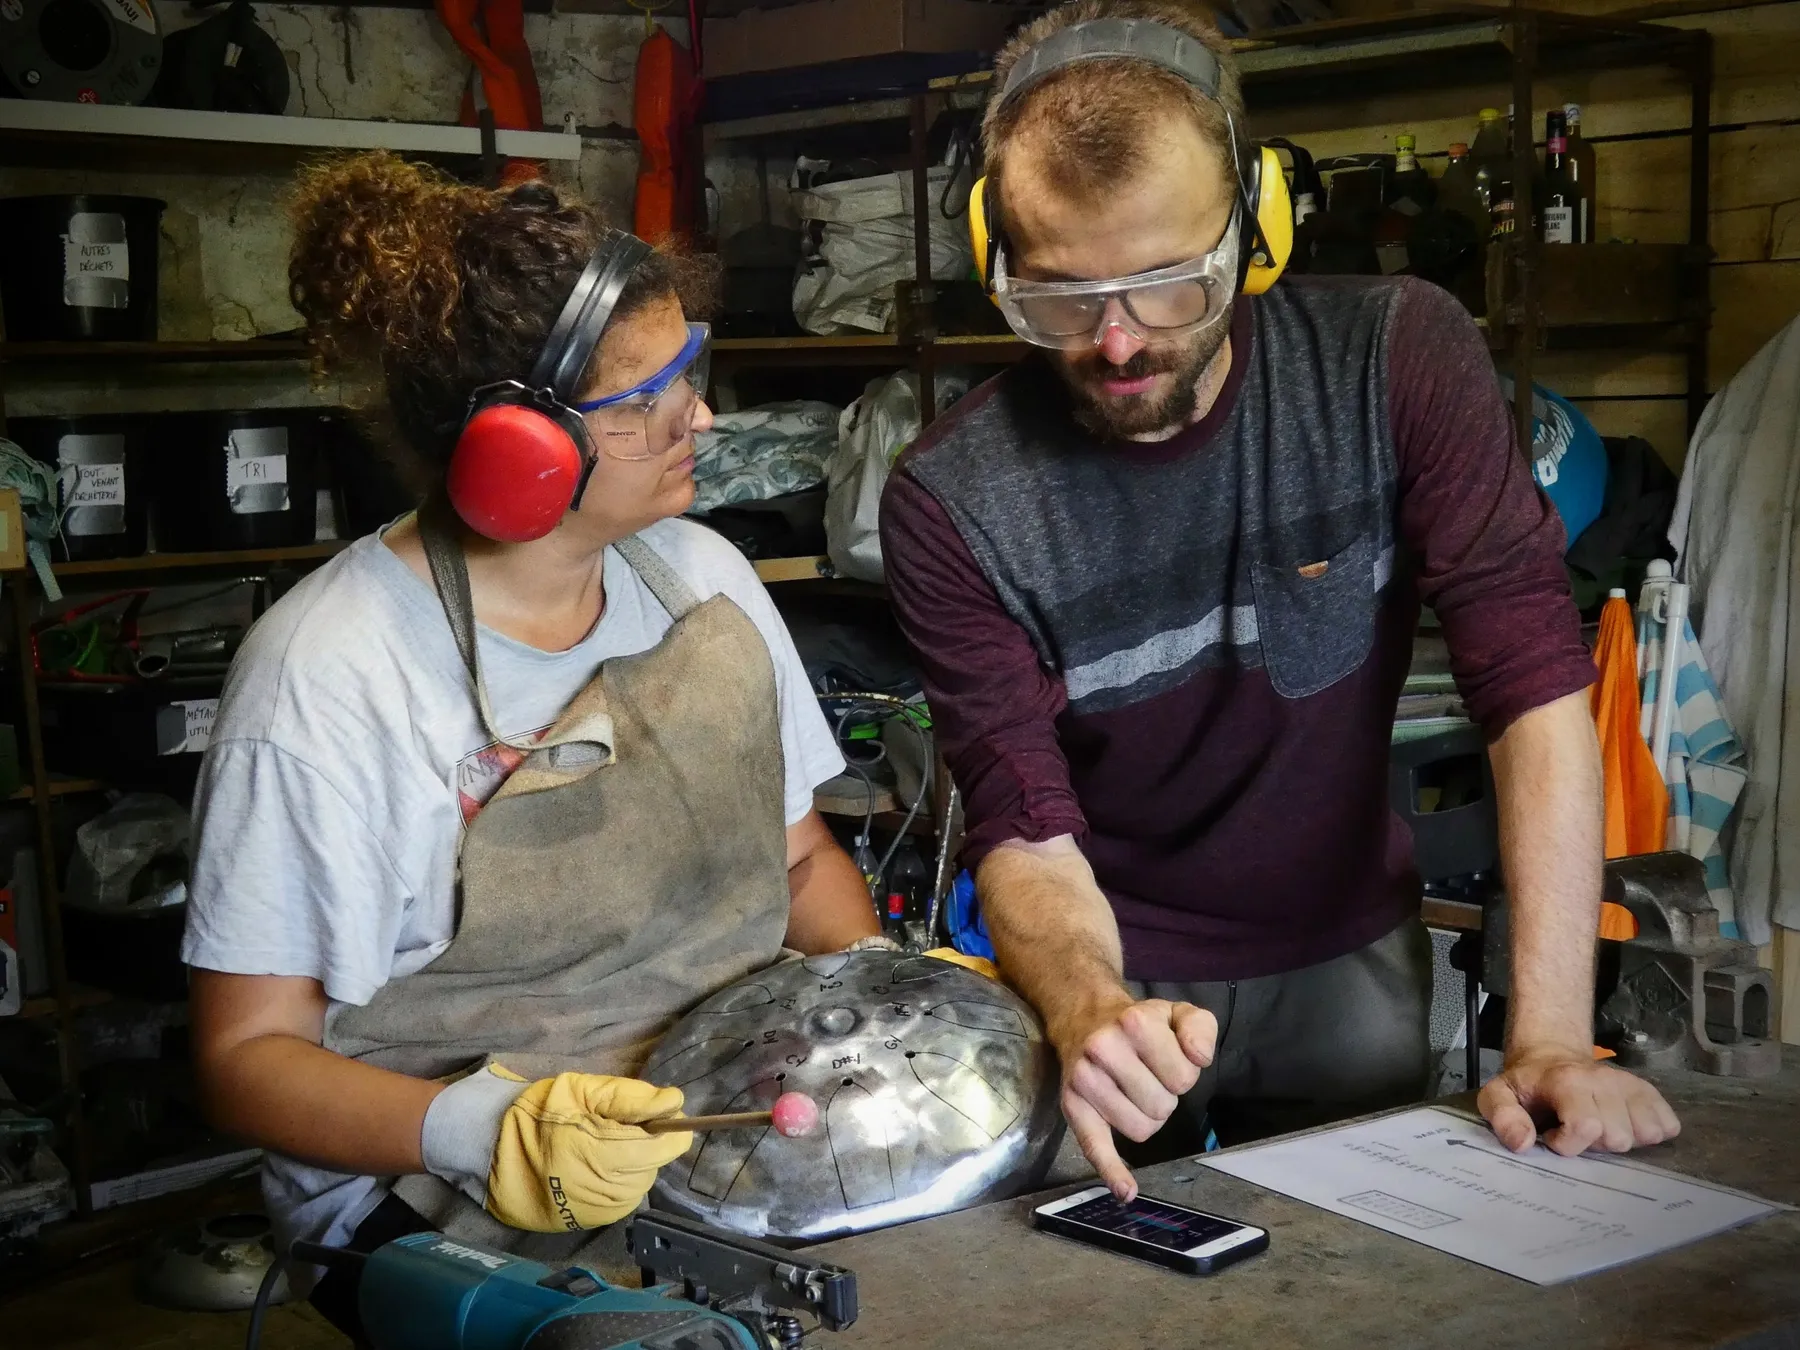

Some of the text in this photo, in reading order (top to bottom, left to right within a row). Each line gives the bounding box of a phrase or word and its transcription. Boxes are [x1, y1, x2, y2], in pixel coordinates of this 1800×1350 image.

[81, 245, 111, 256] AUTRES
[241, 461, 267, 479] TRI
[91, 476, 119, 487] VENANT
[185, 706, 216, 720] MÉTAU
[189, 725, 209, 736] UTIL
